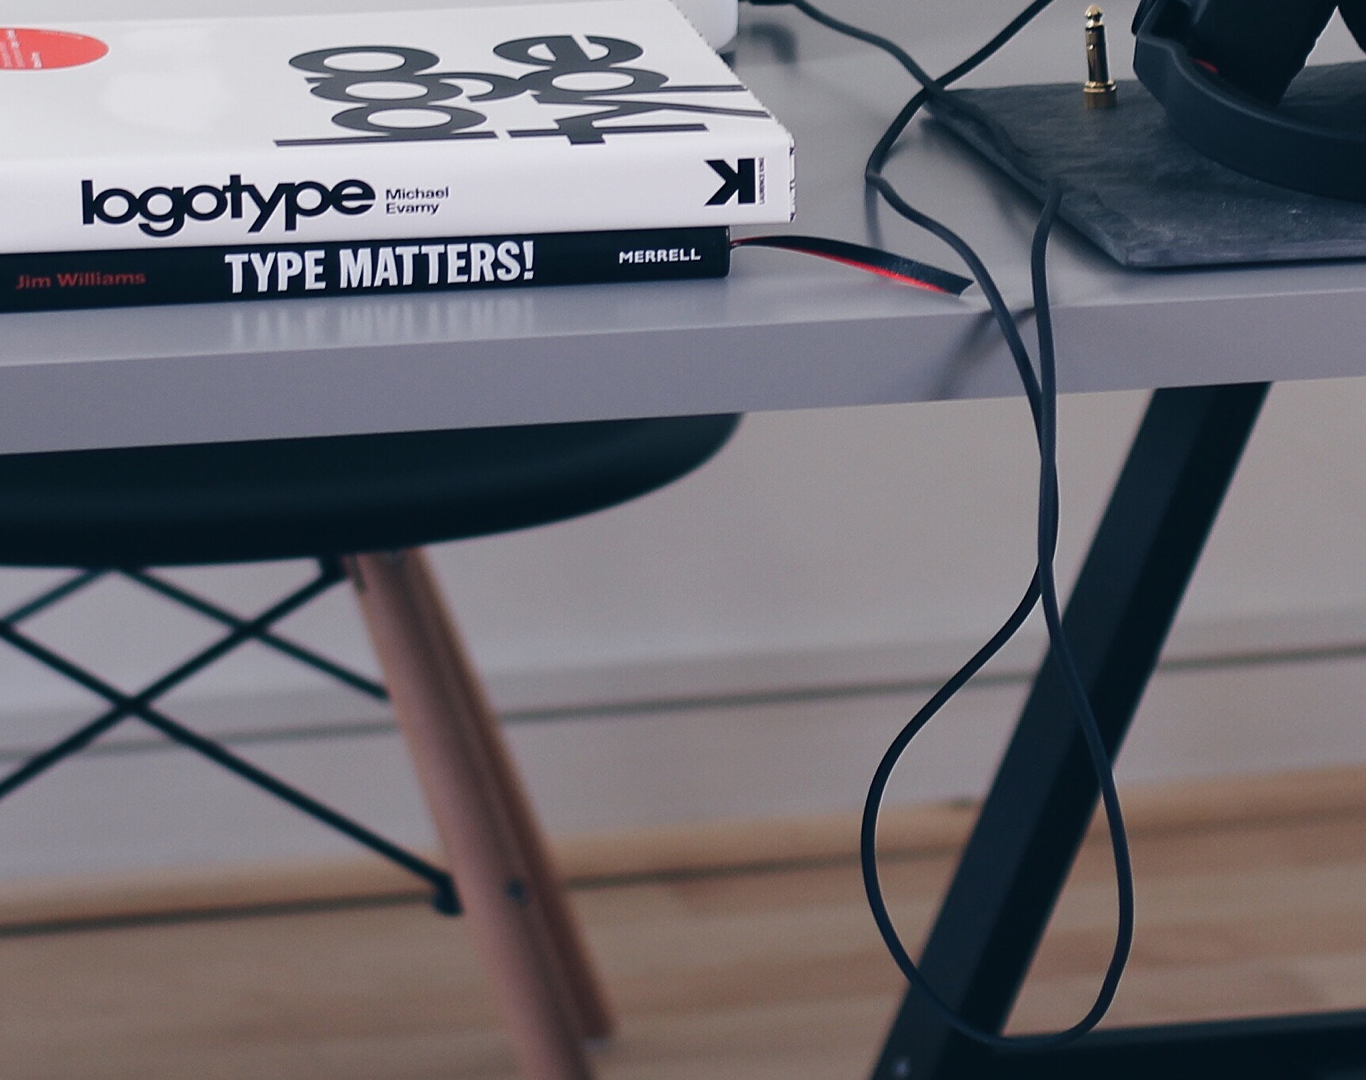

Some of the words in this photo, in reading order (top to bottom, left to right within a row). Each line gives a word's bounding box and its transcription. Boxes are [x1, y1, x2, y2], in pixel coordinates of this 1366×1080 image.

[273, 46, 533, 147] logo
[493, 35, 774, 145] type
[81, 174, 376, 238] logotype
[386, 186, 449, 201] Michael
[386, 201, 439, 215] Evamy
[224, 250, 327, 294] TYPE
[339, 240, 535, 289] MATTERS!
[618, 249, 701, 264] MERRELL
[15, 275, 51, 290] Jim
[57, 271, 147, 287] Williams
